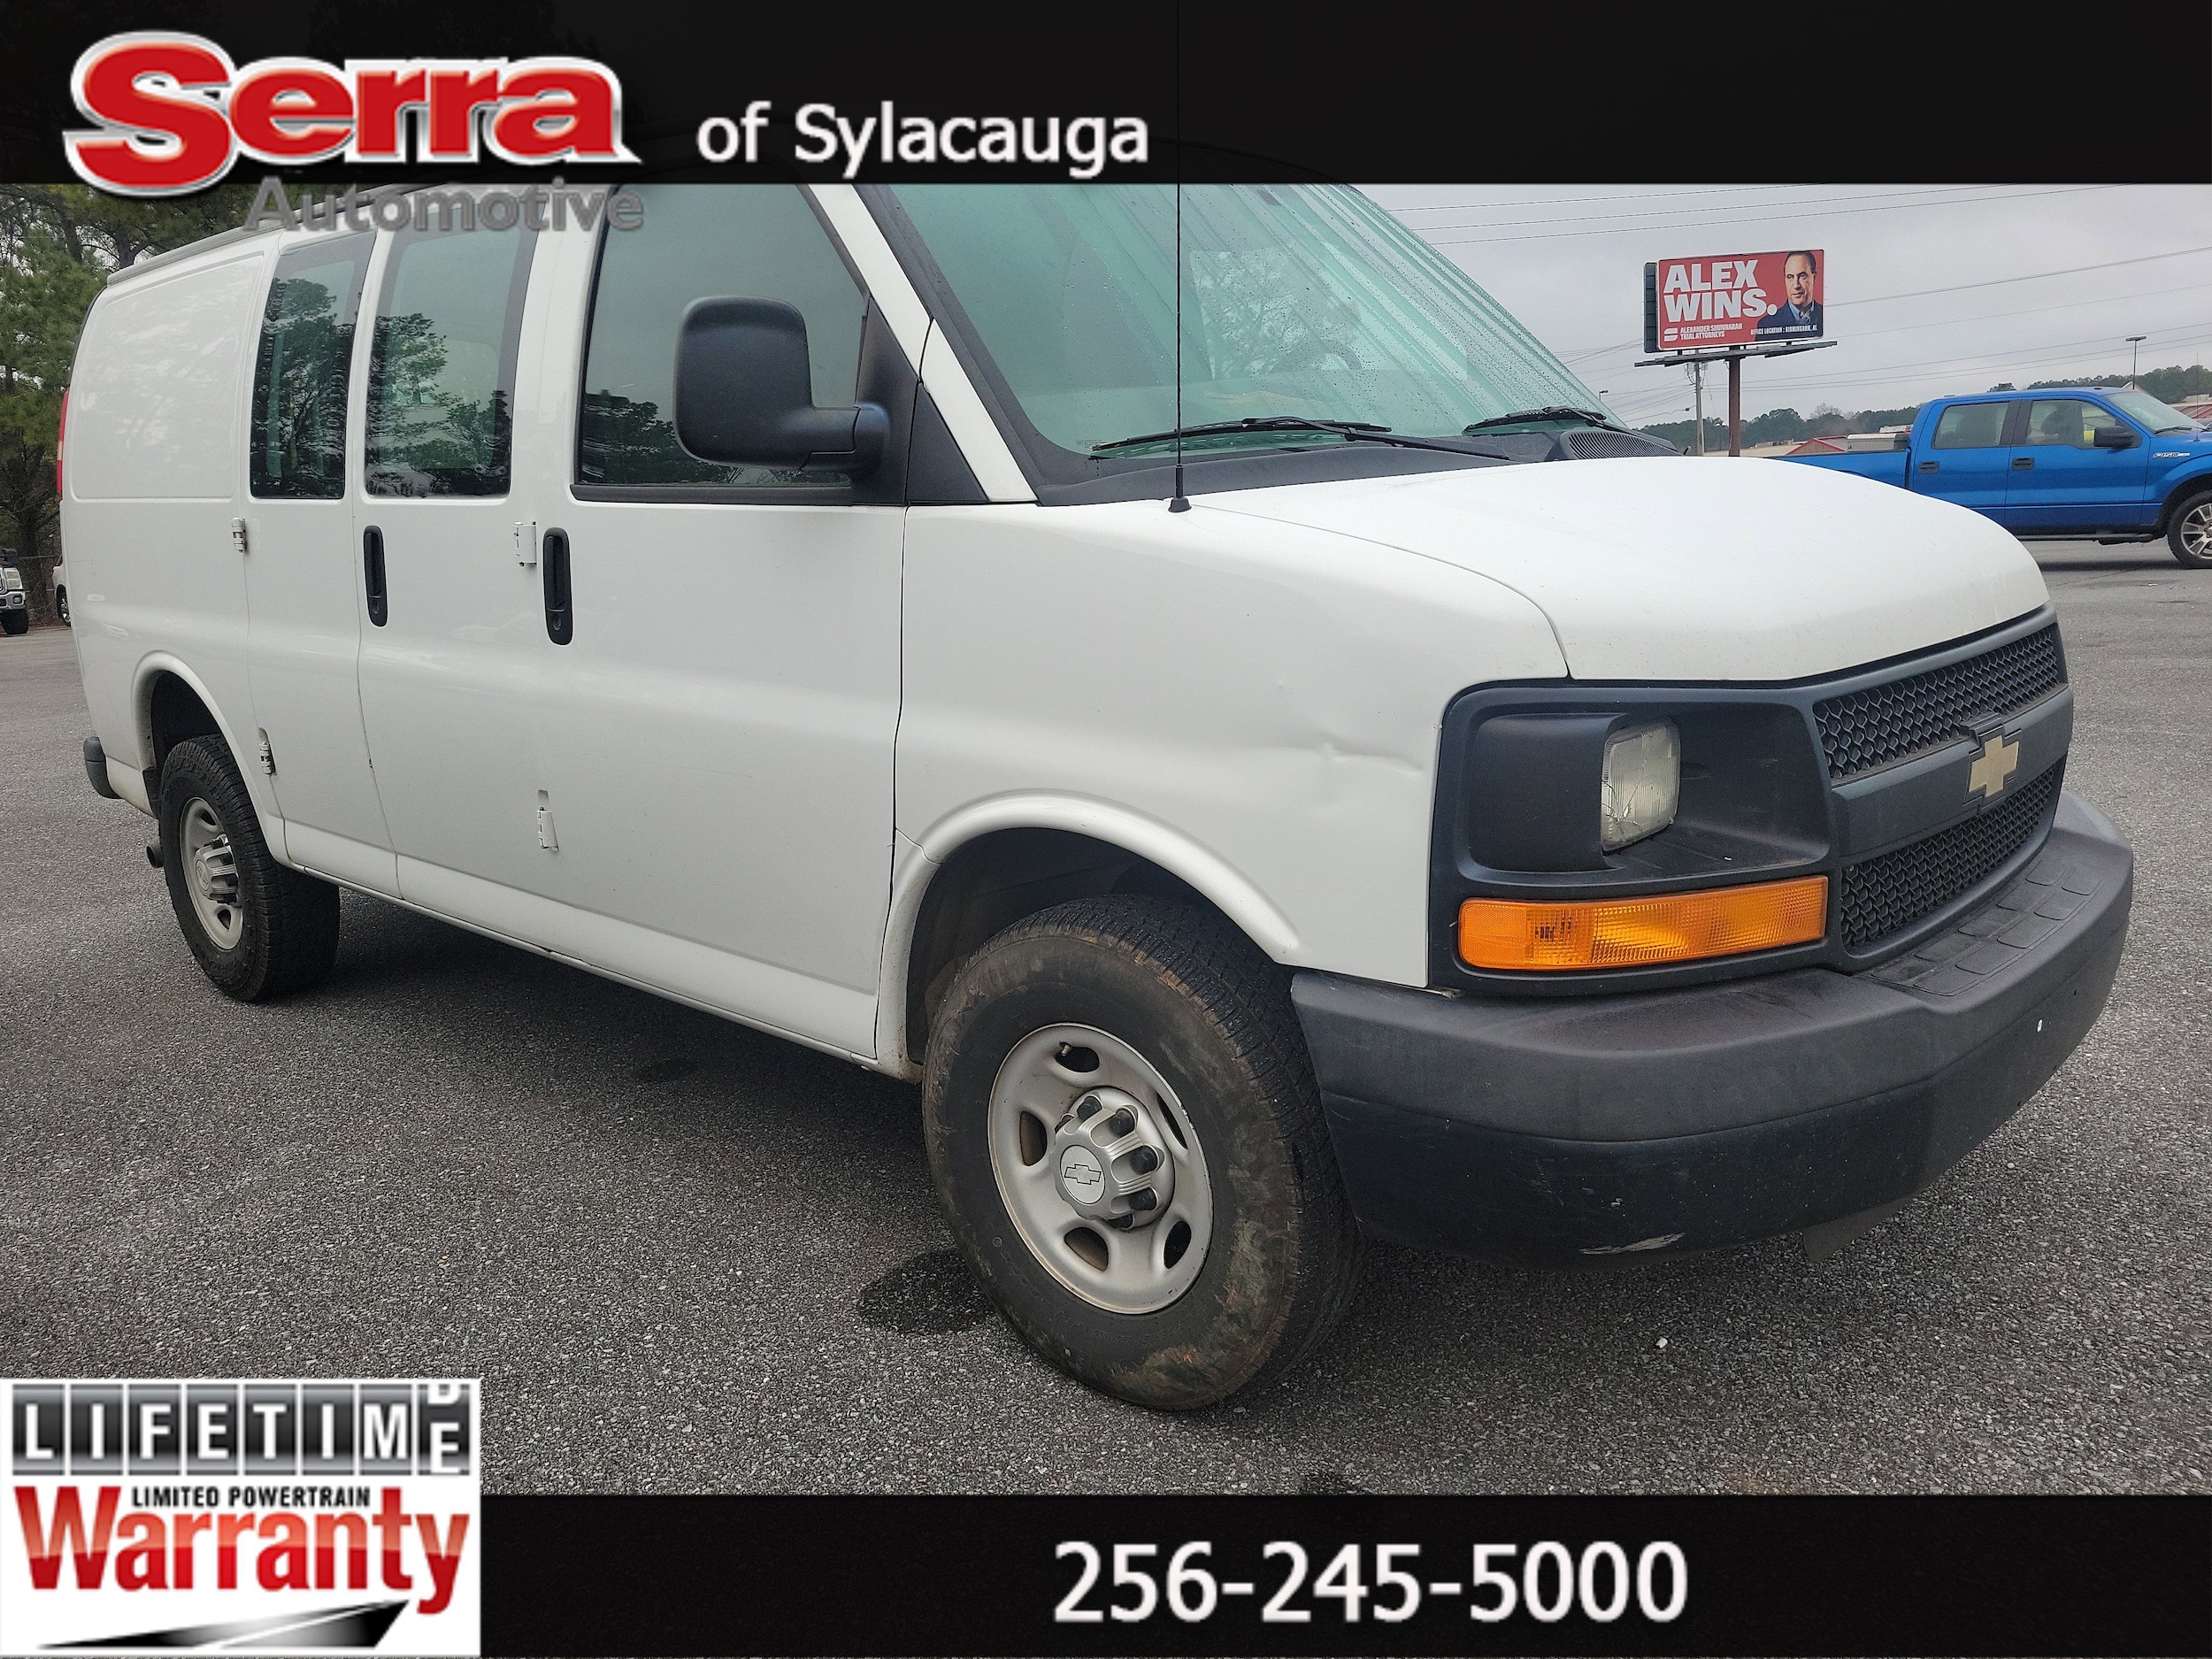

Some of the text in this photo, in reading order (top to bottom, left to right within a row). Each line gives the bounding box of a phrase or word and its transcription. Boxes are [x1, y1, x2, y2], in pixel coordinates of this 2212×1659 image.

[1663, 259, 1758, 293] ALEX
[1663, 288, 1778, 322] WINS.
[1680, 325, 1710, 334] ALEXANDER
